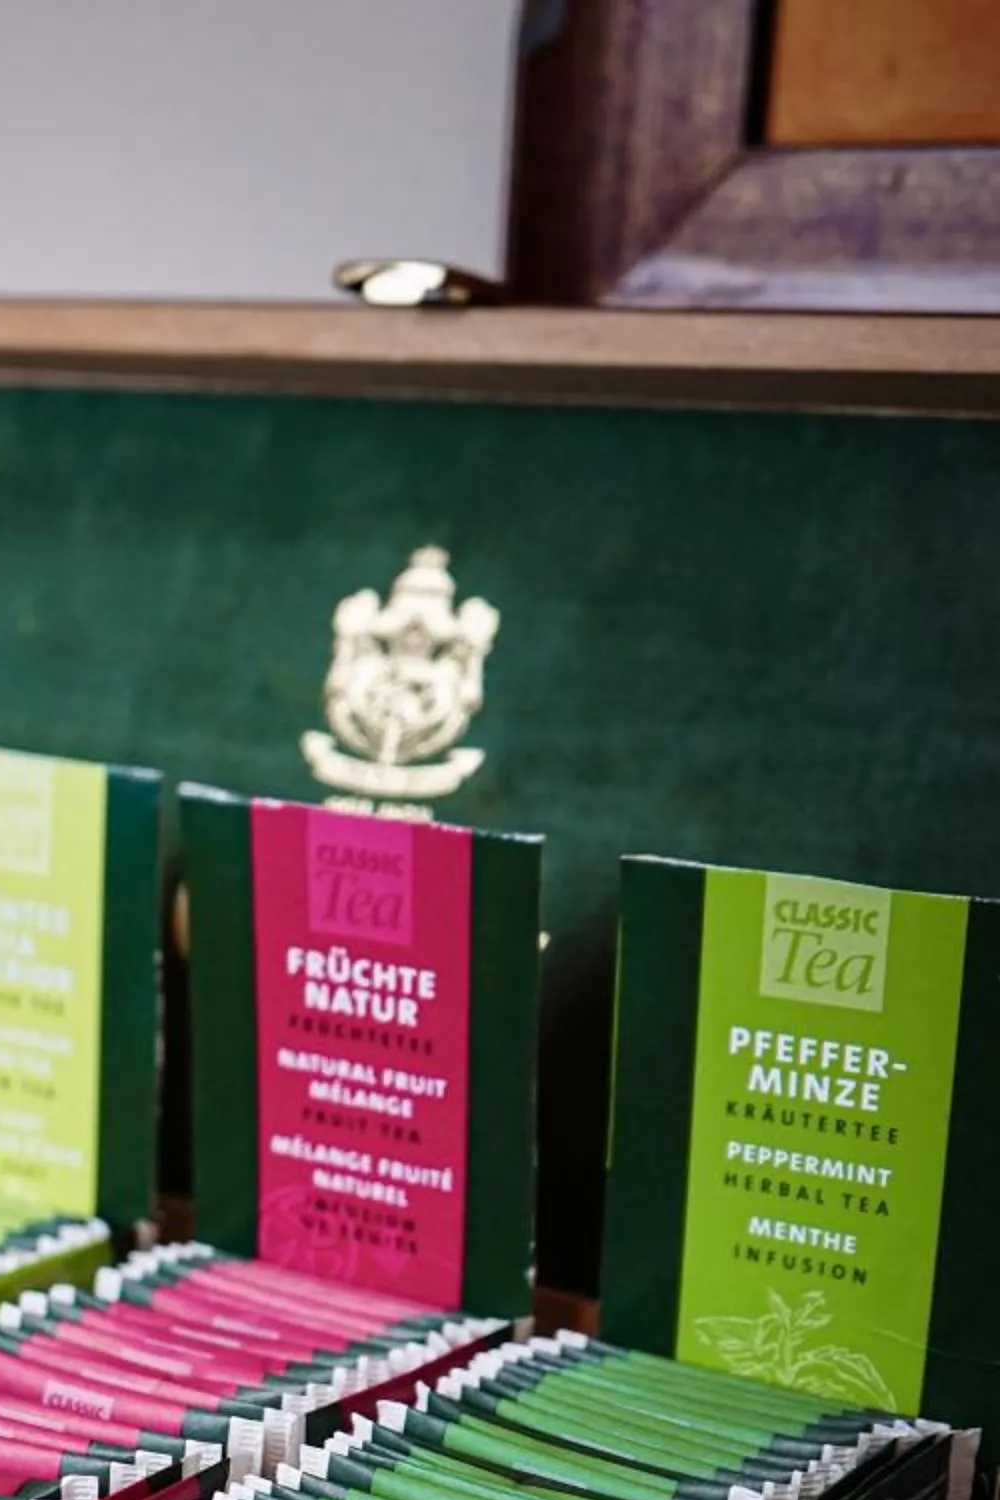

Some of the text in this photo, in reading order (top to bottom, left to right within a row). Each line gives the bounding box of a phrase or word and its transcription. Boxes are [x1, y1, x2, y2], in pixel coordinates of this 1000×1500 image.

[317, 844, 404, 879] CLASSIC
[313, 866, 404, 931] Tea
[774, 898, 880, 936] CLASSIC
[285, 945, 438, 999] FRÜCHTE
[771, 926, 876, 995] Tea
[303, 980, 420, 1028] NATUR
[276, 1047, 448, 1099] NATURAL FRUIT
[728, 1026, 908, 1079] PFEFFER-
[308, 1078, 414, 1119] MÉLANGE
[747, 1063, 881, 1113] MINZE
[725, 1100, 900, 1146] KRÄUTERTEE
[270, 1133, 453, 1192] MÉLANGE FRUITÉ
[727, 1141, 893, 1187] PEPPERMINT
[312, 1168, 409, 1208] NATUREL
[723, 1172, 890, 1217] HERBAL TEA
[748, 1216, 857, 1254] MENTHE
[734, 1245, 868, 1285] INFUSION
